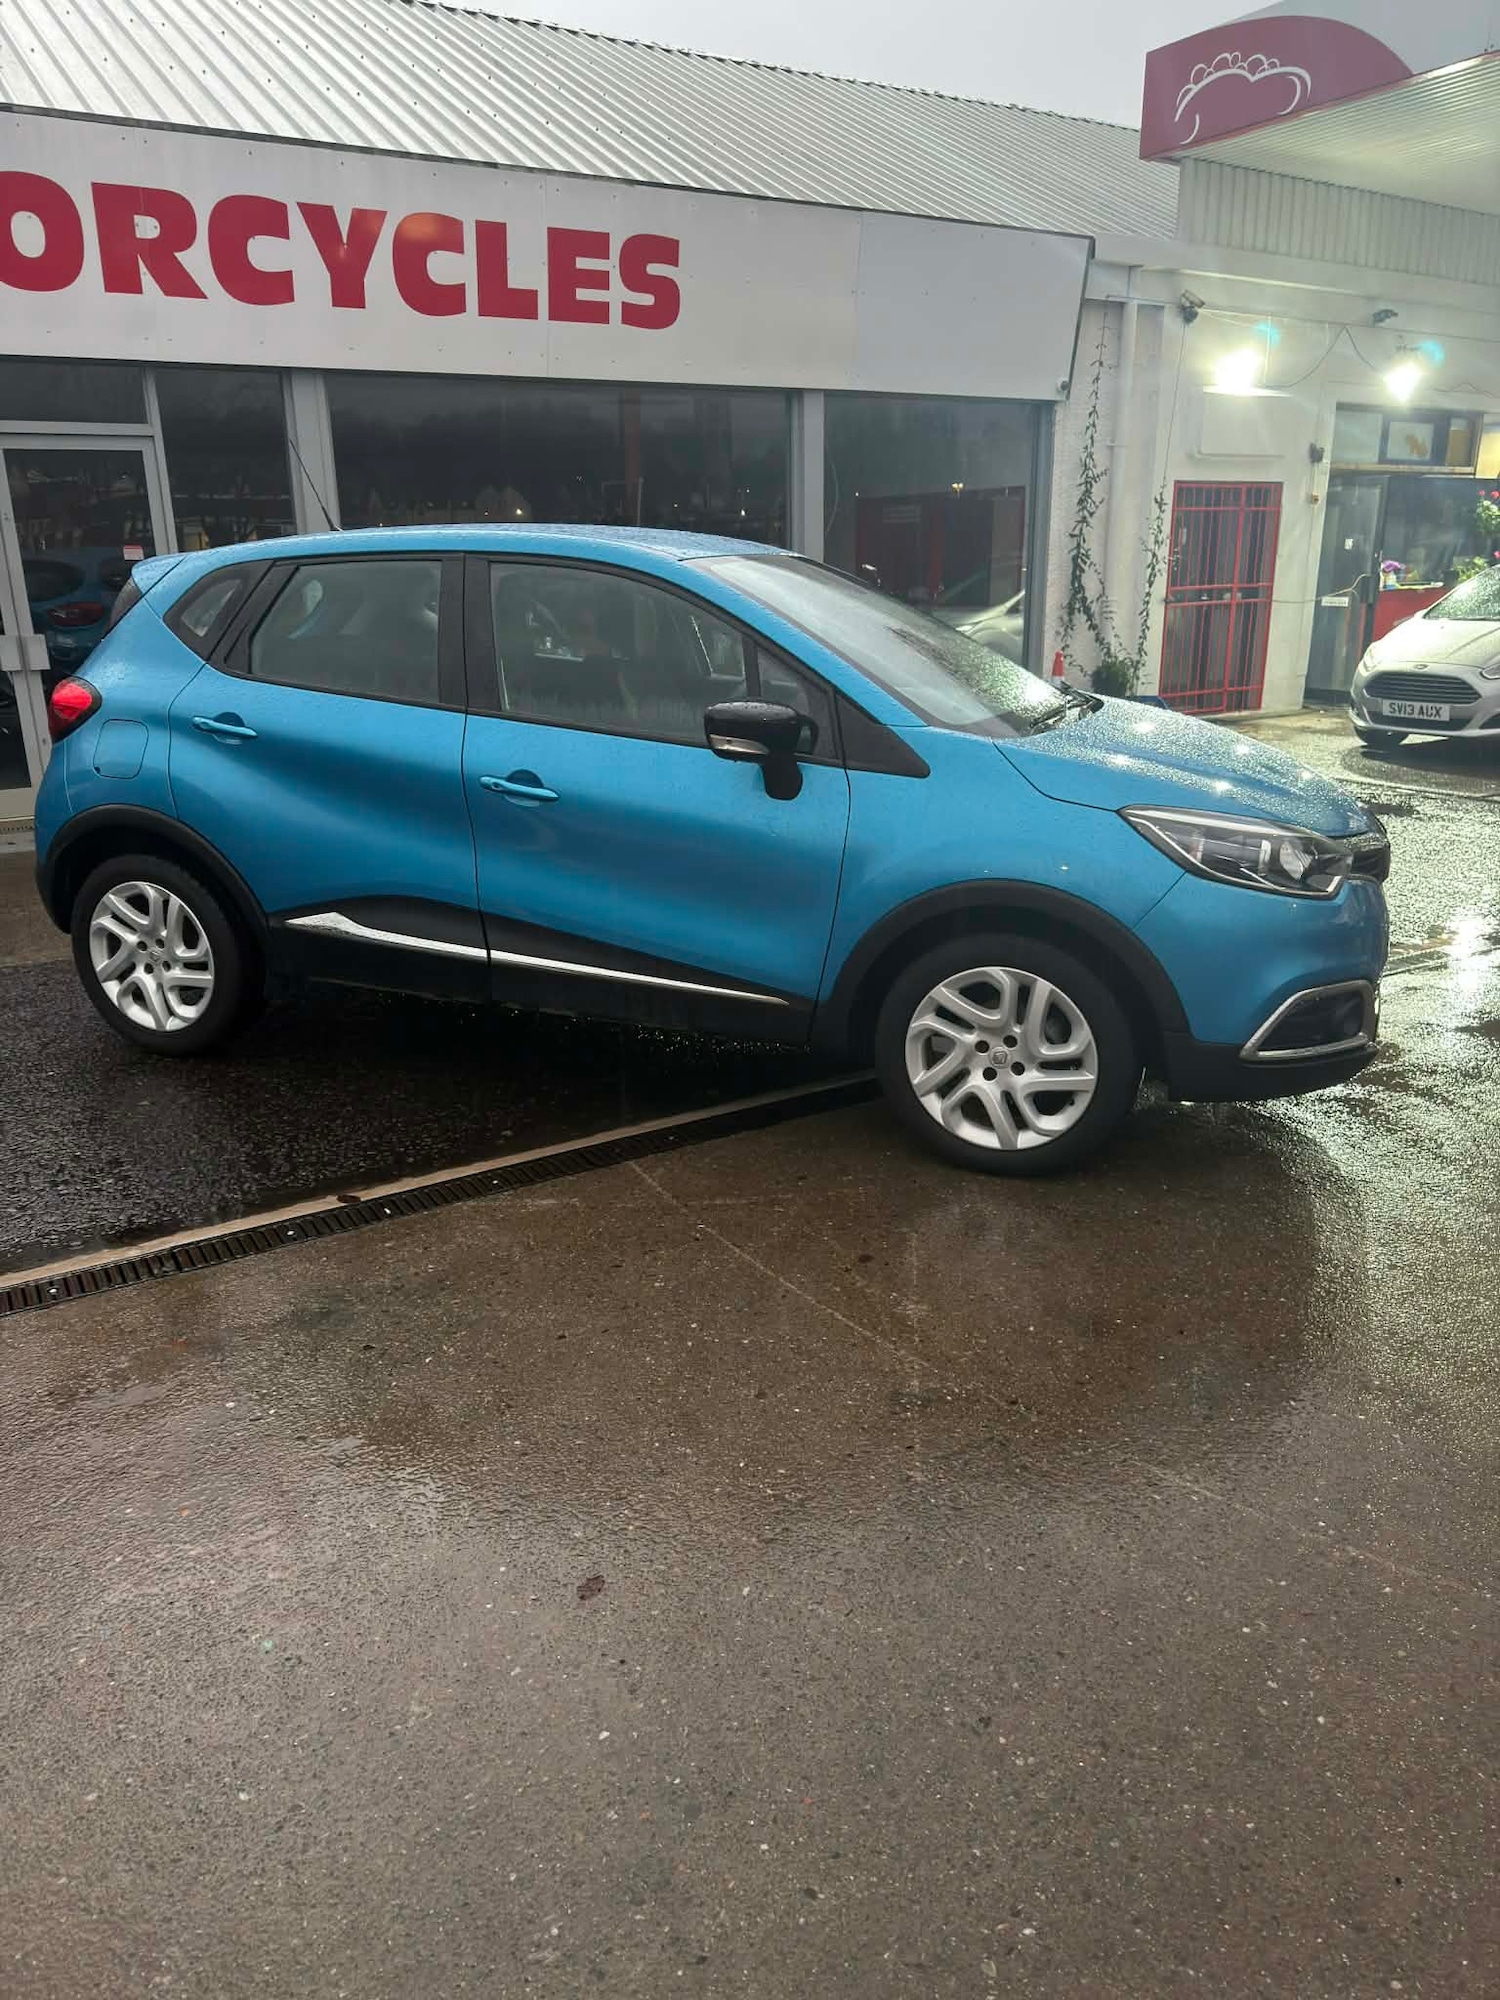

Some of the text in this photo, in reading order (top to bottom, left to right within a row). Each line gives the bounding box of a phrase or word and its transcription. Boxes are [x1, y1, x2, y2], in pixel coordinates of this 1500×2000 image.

[0, 171, 680, 330] ORCYCLES
[1389, 702, 1443, 719] SV13 AUX
